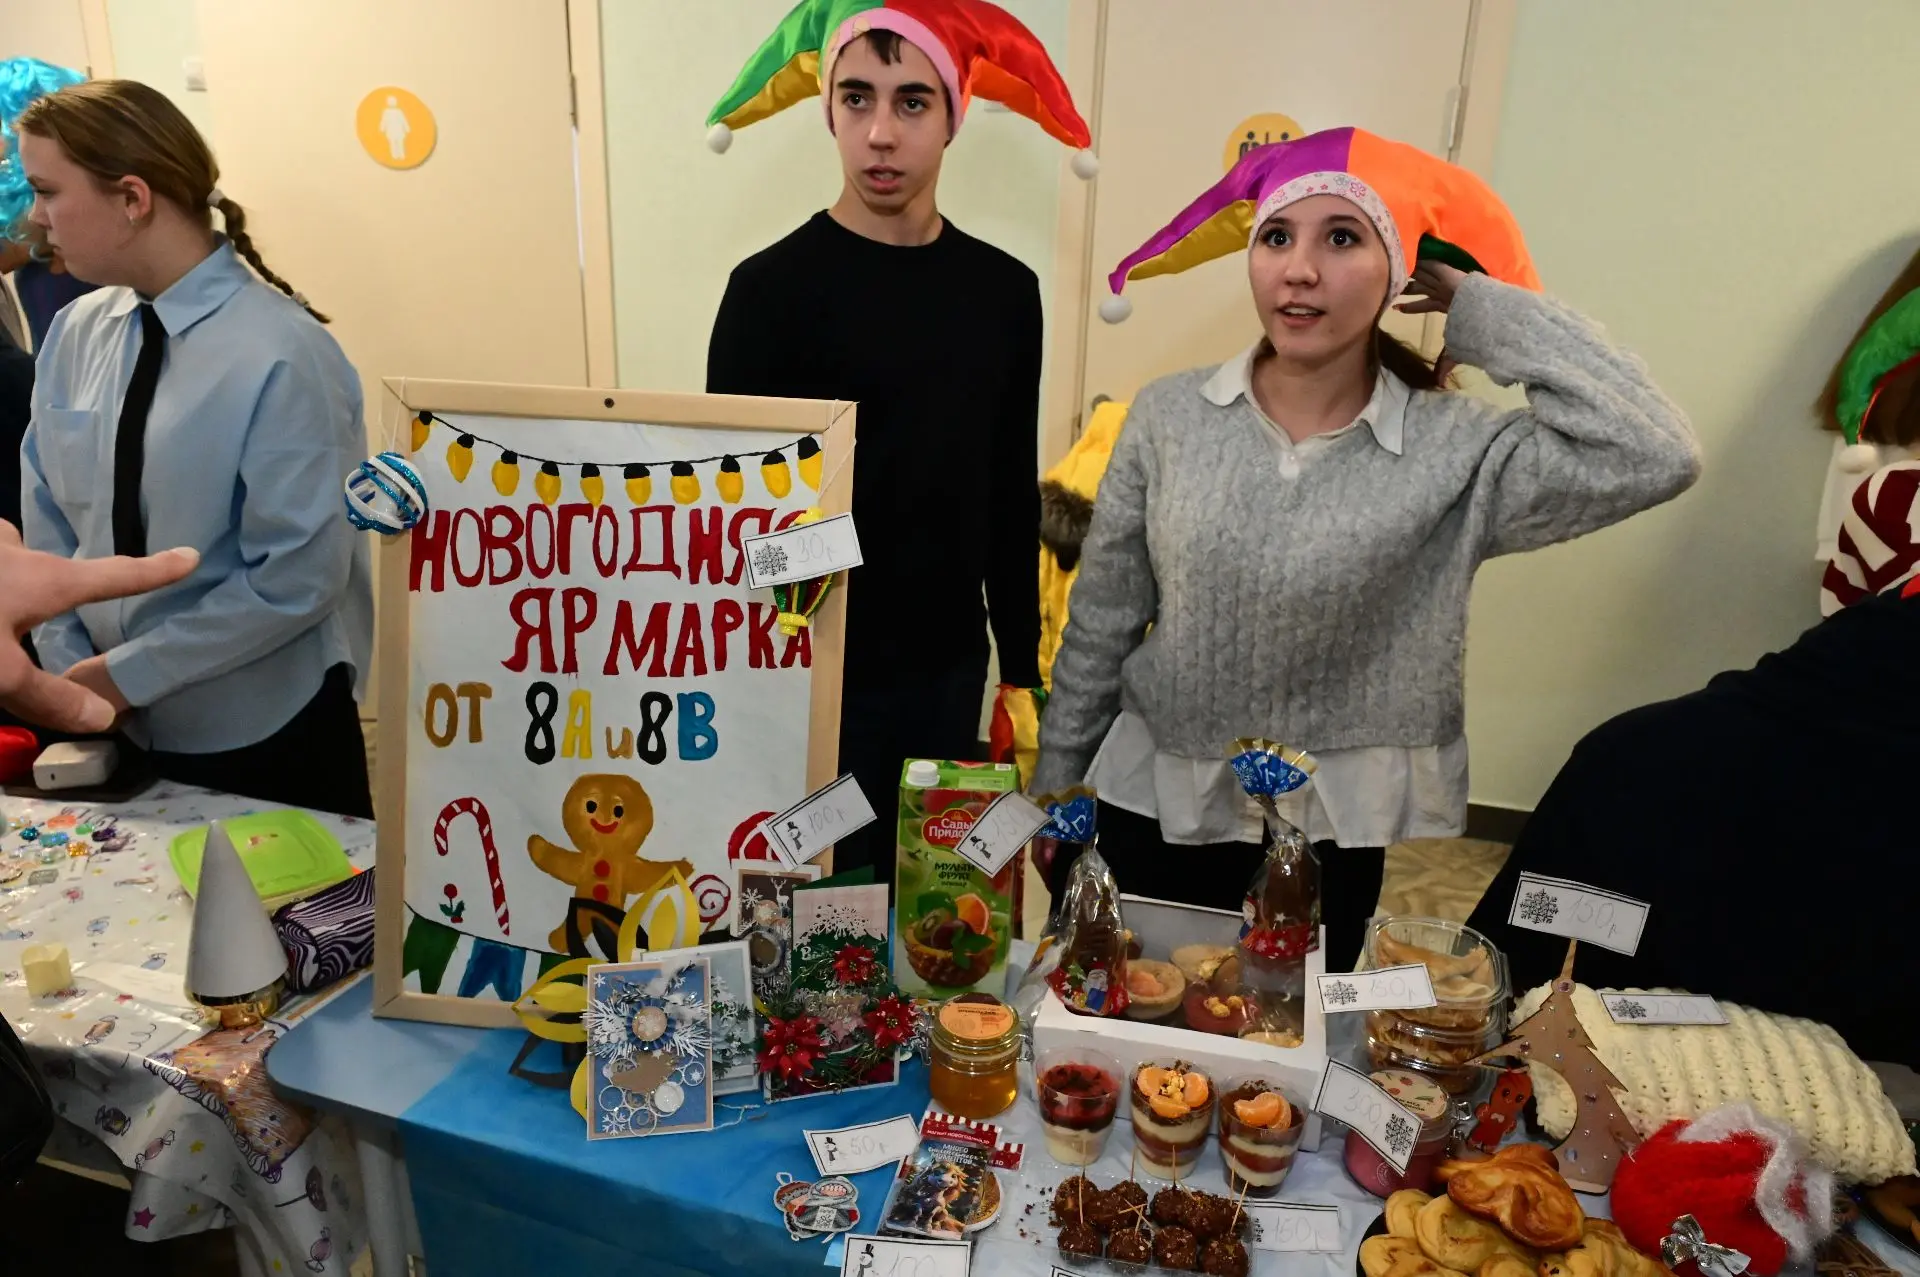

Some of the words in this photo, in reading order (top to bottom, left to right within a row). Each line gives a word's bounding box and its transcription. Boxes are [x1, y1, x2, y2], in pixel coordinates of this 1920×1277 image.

[502, 587, 813, 677] ЯРМАРКА
[424, 681, 492, 748] ОТ
[929, 826, 966, 839] Придо
